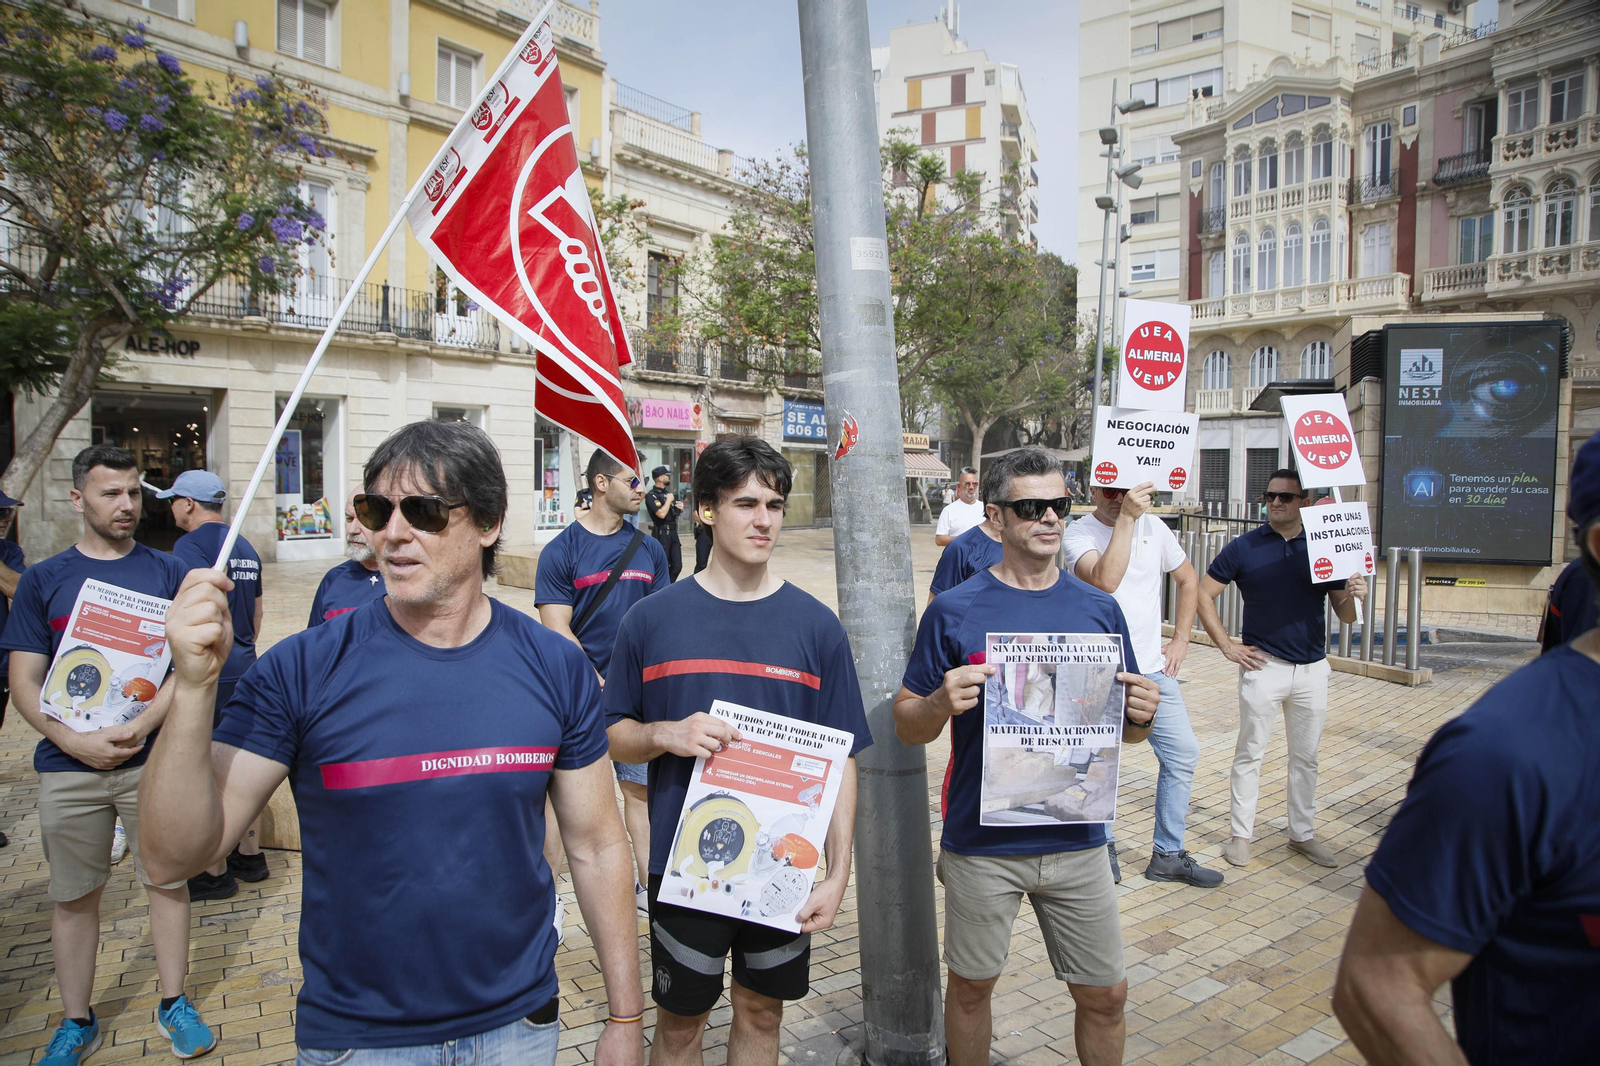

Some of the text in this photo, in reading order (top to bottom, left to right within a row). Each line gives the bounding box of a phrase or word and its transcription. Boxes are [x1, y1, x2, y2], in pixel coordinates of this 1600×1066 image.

[857, 250, 884, 259] 35922
[1140, 326, 1173, 341] UEA
[125, 334, 201, 356] ALE-HOP
[1128, 348, 1182, 363] ALMERIA
[1133, 367, 1176, 385] UEMA
[1399, 387, 1441, 398] NEST
[645, 406, 690, 420] BAO NAILS
[787, 411, 806, 424] SE
[1302, 414, 1335, 426] UEA
[787, 424, 827, 437] 606 9
[1107, 419, 1190, 435] NEGOCIACIÓN
[1117, 437, 1175, 450] ACUERDO
[1298, 434, 1350, 445] ALMERIA
[1136, 456, 1161, 466] YA!!!
[1307, 450, 1349, 464] UEMA
[1450, 474, 1495, 483] Tenemos
[1512, 472, 1538, 485] plan
[1413, 481, 1434, 497] AI
[1449, 485, 1471, 494] para
[1473, 485, 1508, 494] vender
[1466, 494, 1481, 504] 30
[1484, 493, 1508, 504] días
[1323, 512, 1362, 523] POR UNAS
[1310, 526, 1370, 541] INSTALACIONES
[1335, 541, 1363, 553] DIGNAS
[97, 587, 119, 597] MEDIOS
[119, 593, 136, 602] PARA
[137, 599, 160, 609] PODER
[81, 606, 89, 615] 5
[99, 594, 112, 603] UNA
[112, 598, 125, 607] RCP
[135, 604, 164, 616] CALIDAD
[992, 645, 1011, 653] SIN
[1066, 645, 1078, 653] LA
[1080, 645, 1118, 653] CALIDAD
[1006, 655, 1111, 663] DEL SERVICIO MENGUA
[765, 667, 800, 678] BOMBEROS
[715, 708, 847, 746] SIN MEDIOS PARA PODER HACER
[990, 725, 1115, 735] MATERIAL ANACRÓNICO
[737, 723, 823, 750] UNA RCP DE CALIDAD
[1021, 737, 1085, 746] DE RESCATE
[753, 749, 782, 759] ESENCIALES
[421, 752, 555, 772] DIGNIDAD BOMBEROS
[706, 767, 713, 776] 4.
